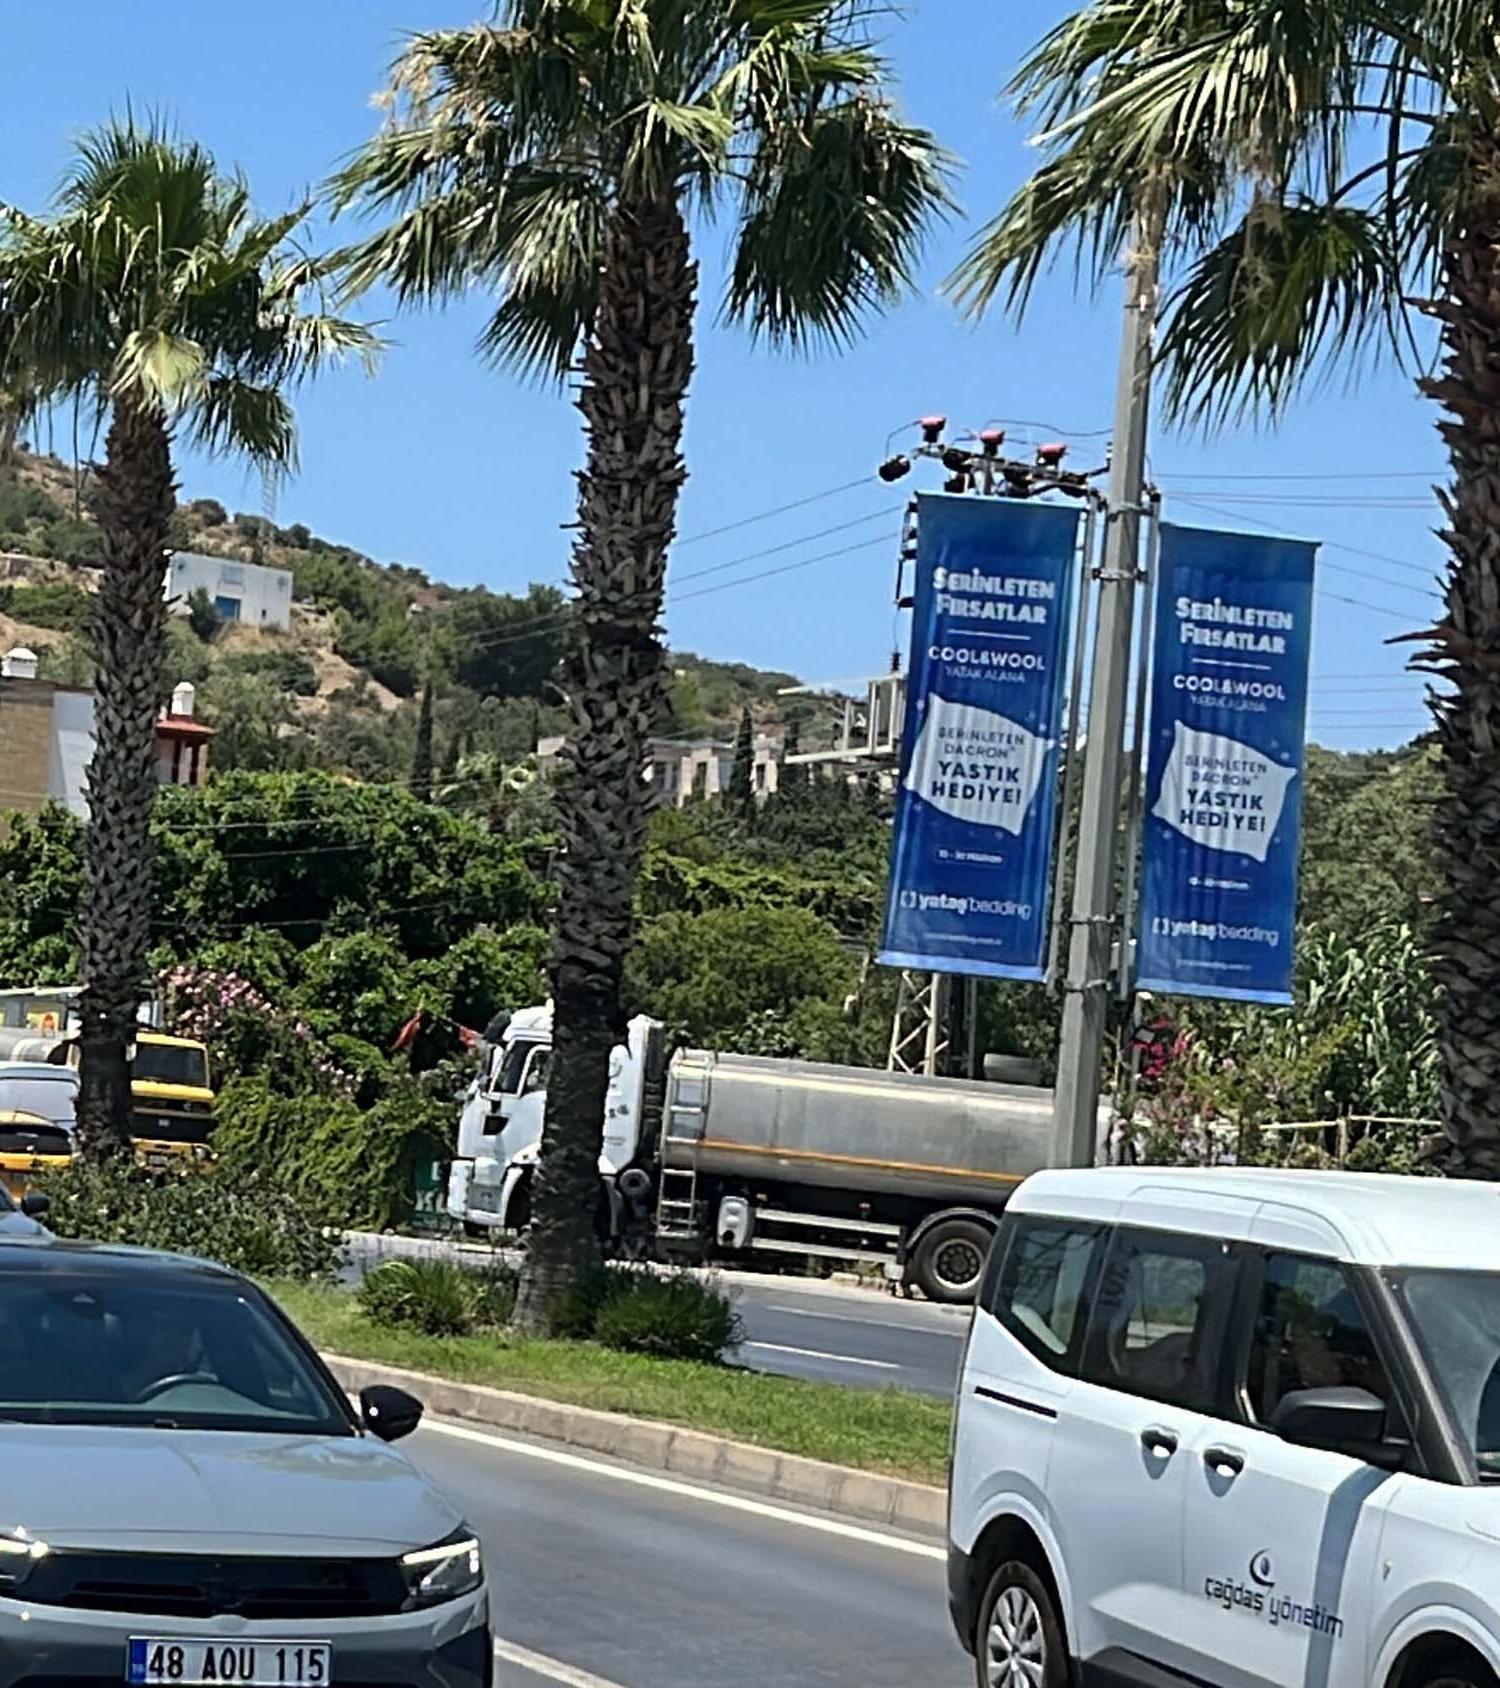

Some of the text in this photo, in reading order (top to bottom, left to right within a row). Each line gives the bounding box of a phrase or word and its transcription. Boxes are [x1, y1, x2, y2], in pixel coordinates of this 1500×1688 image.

[928, 646, 1045, 670] COOL&WOOL
[1173, 674, 1286, 700] COOL&WOOL
[938, 760, 1020, 783] YASTIK
[931, 781, 1022, 805] HEDİYE!
[1187, 788, 1263, 811] YASTIK
[1180, 809, 1266, 833] HEDİYE!
[1204, 1577, 1345, 1639] çağdaş yönetim
[149, 1645, 325, 1681] 48 AOU 115
